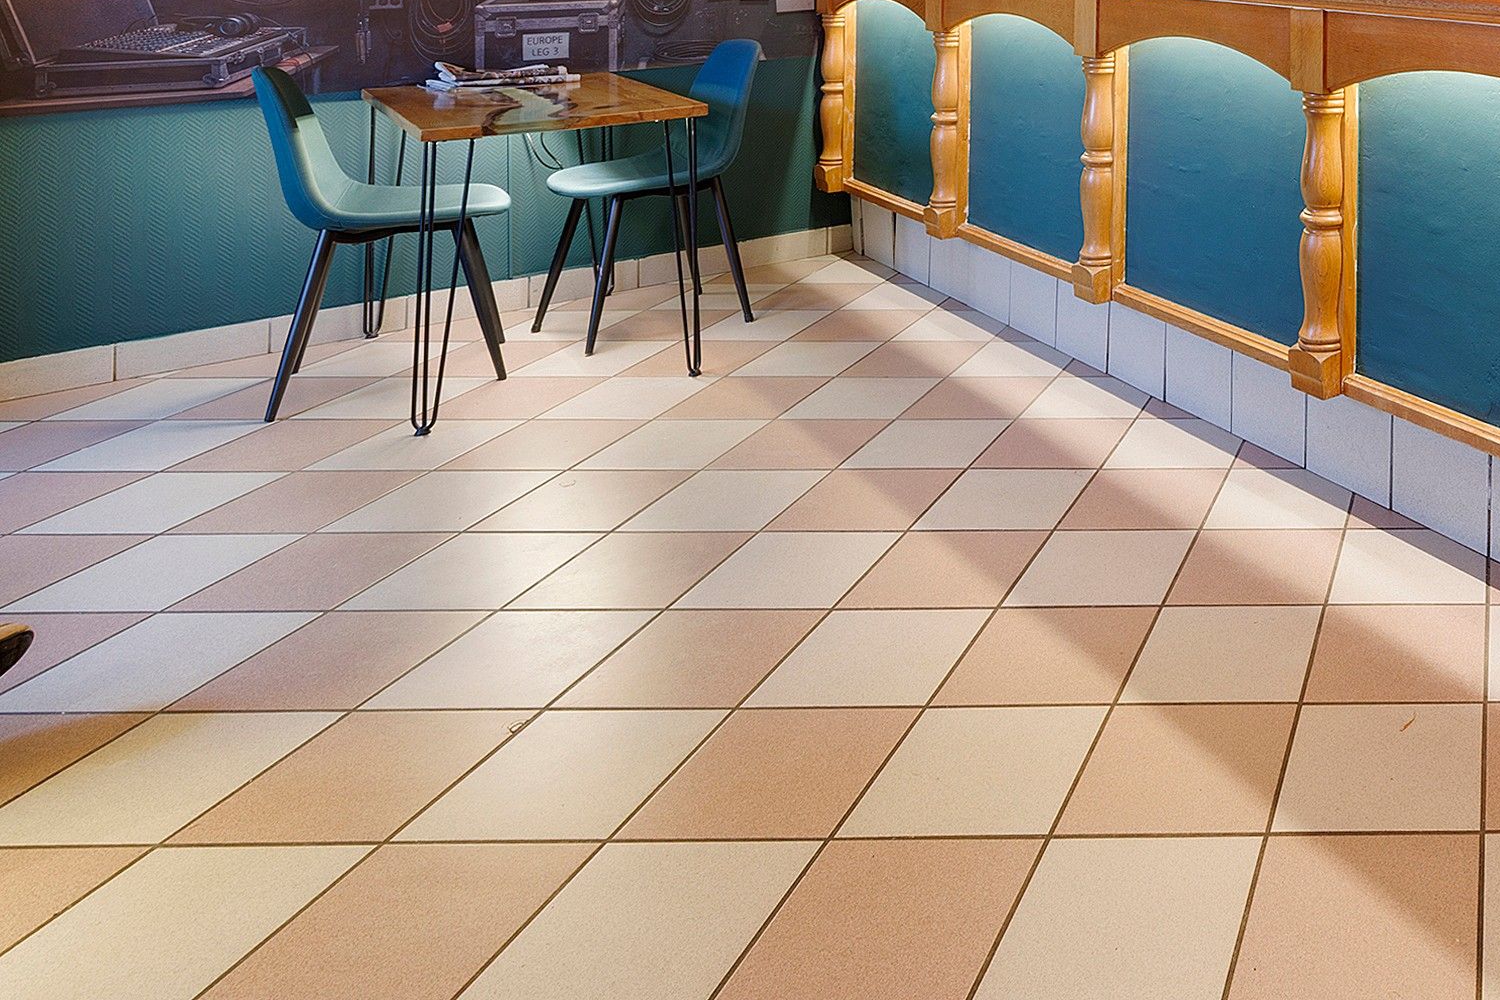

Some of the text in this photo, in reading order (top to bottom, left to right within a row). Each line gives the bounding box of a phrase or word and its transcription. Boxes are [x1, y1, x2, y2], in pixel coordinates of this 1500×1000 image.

[527, 35, 563, 46] EUROPE
[532, 47, 559, 56] LEG 3
